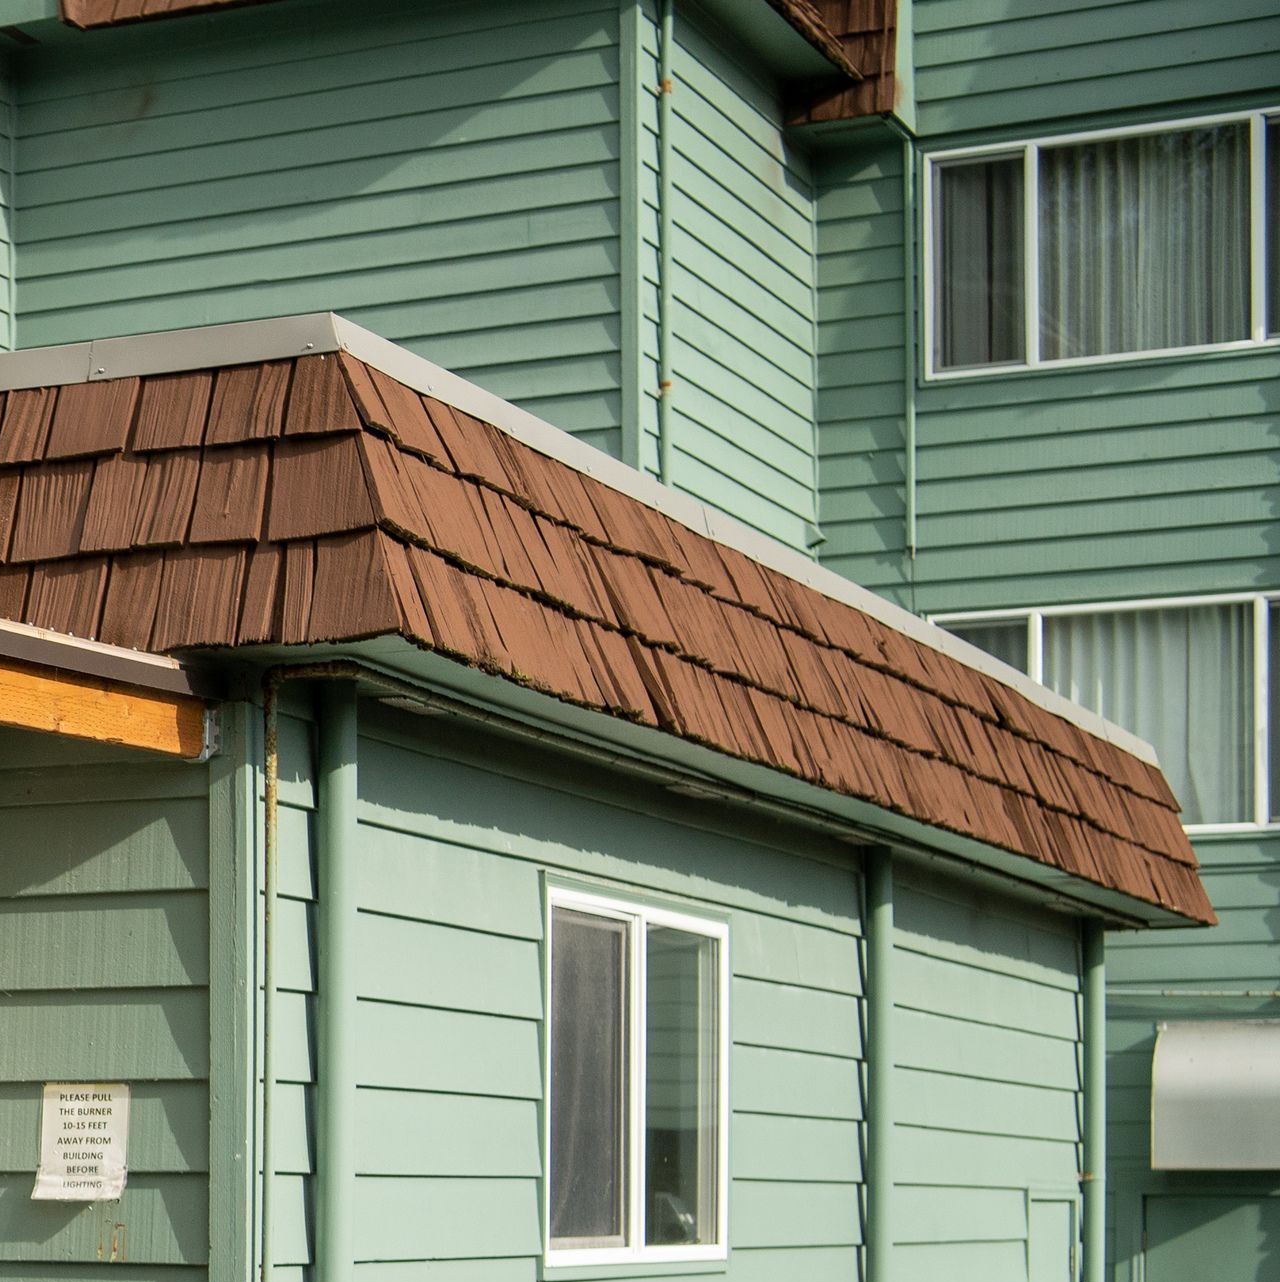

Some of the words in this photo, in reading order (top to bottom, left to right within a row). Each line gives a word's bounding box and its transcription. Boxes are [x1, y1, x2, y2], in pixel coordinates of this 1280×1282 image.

[59, 1108, 74, 1116] THE
[77, 1108, 112, 1116] BURNER
[63, 1122, 86, 1130] 10-15
[88, 1122, 107, 1130] FEET
[57, 1137, 84, 1145] AWAY
[85, 1137, 111, 1145] FROM
[63, 1152, 103, 1160] BUILDING
[66, 1166, 99, 1174] BEFORE
